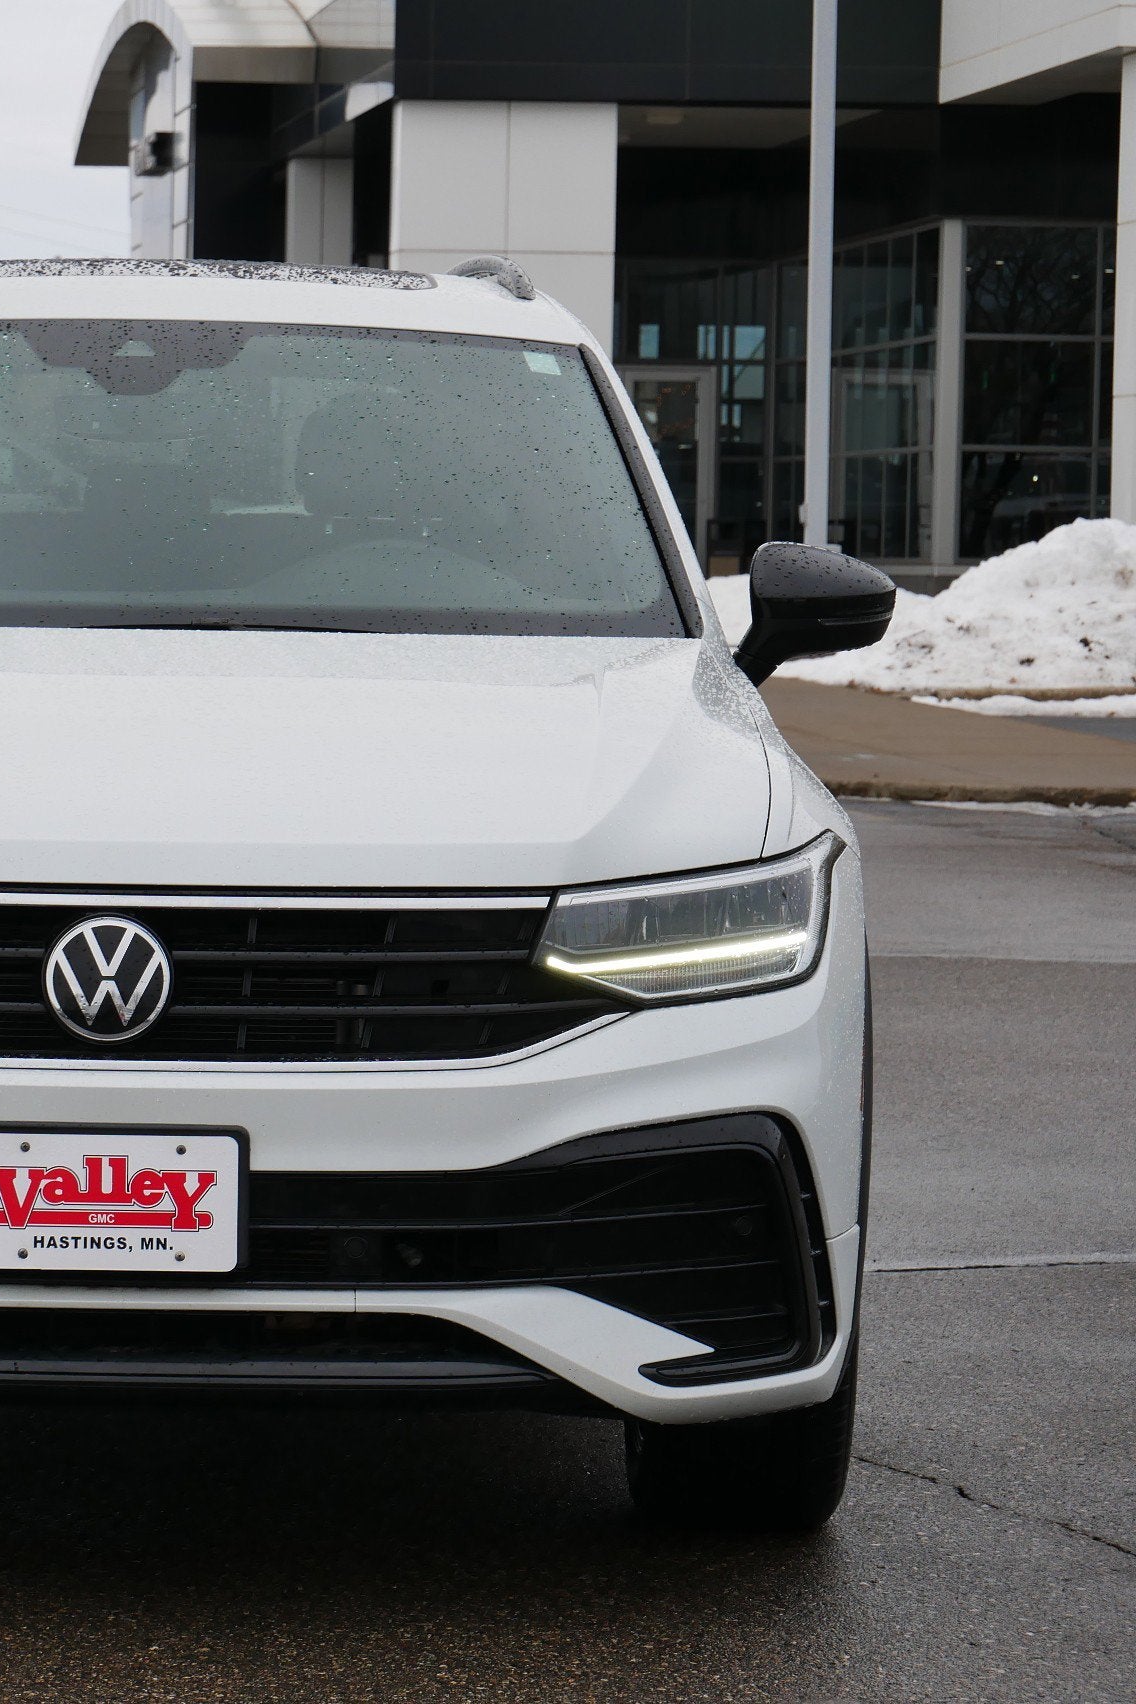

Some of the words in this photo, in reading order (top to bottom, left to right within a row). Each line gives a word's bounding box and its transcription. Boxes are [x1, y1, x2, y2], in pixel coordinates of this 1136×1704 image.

[48, 917, 169, 1038] VW
[88, 1213, 115, 1224] GMC
[33, 1236, 133, 1252] HASTINGS,
[140, 1238, 174, 1251] MN.
